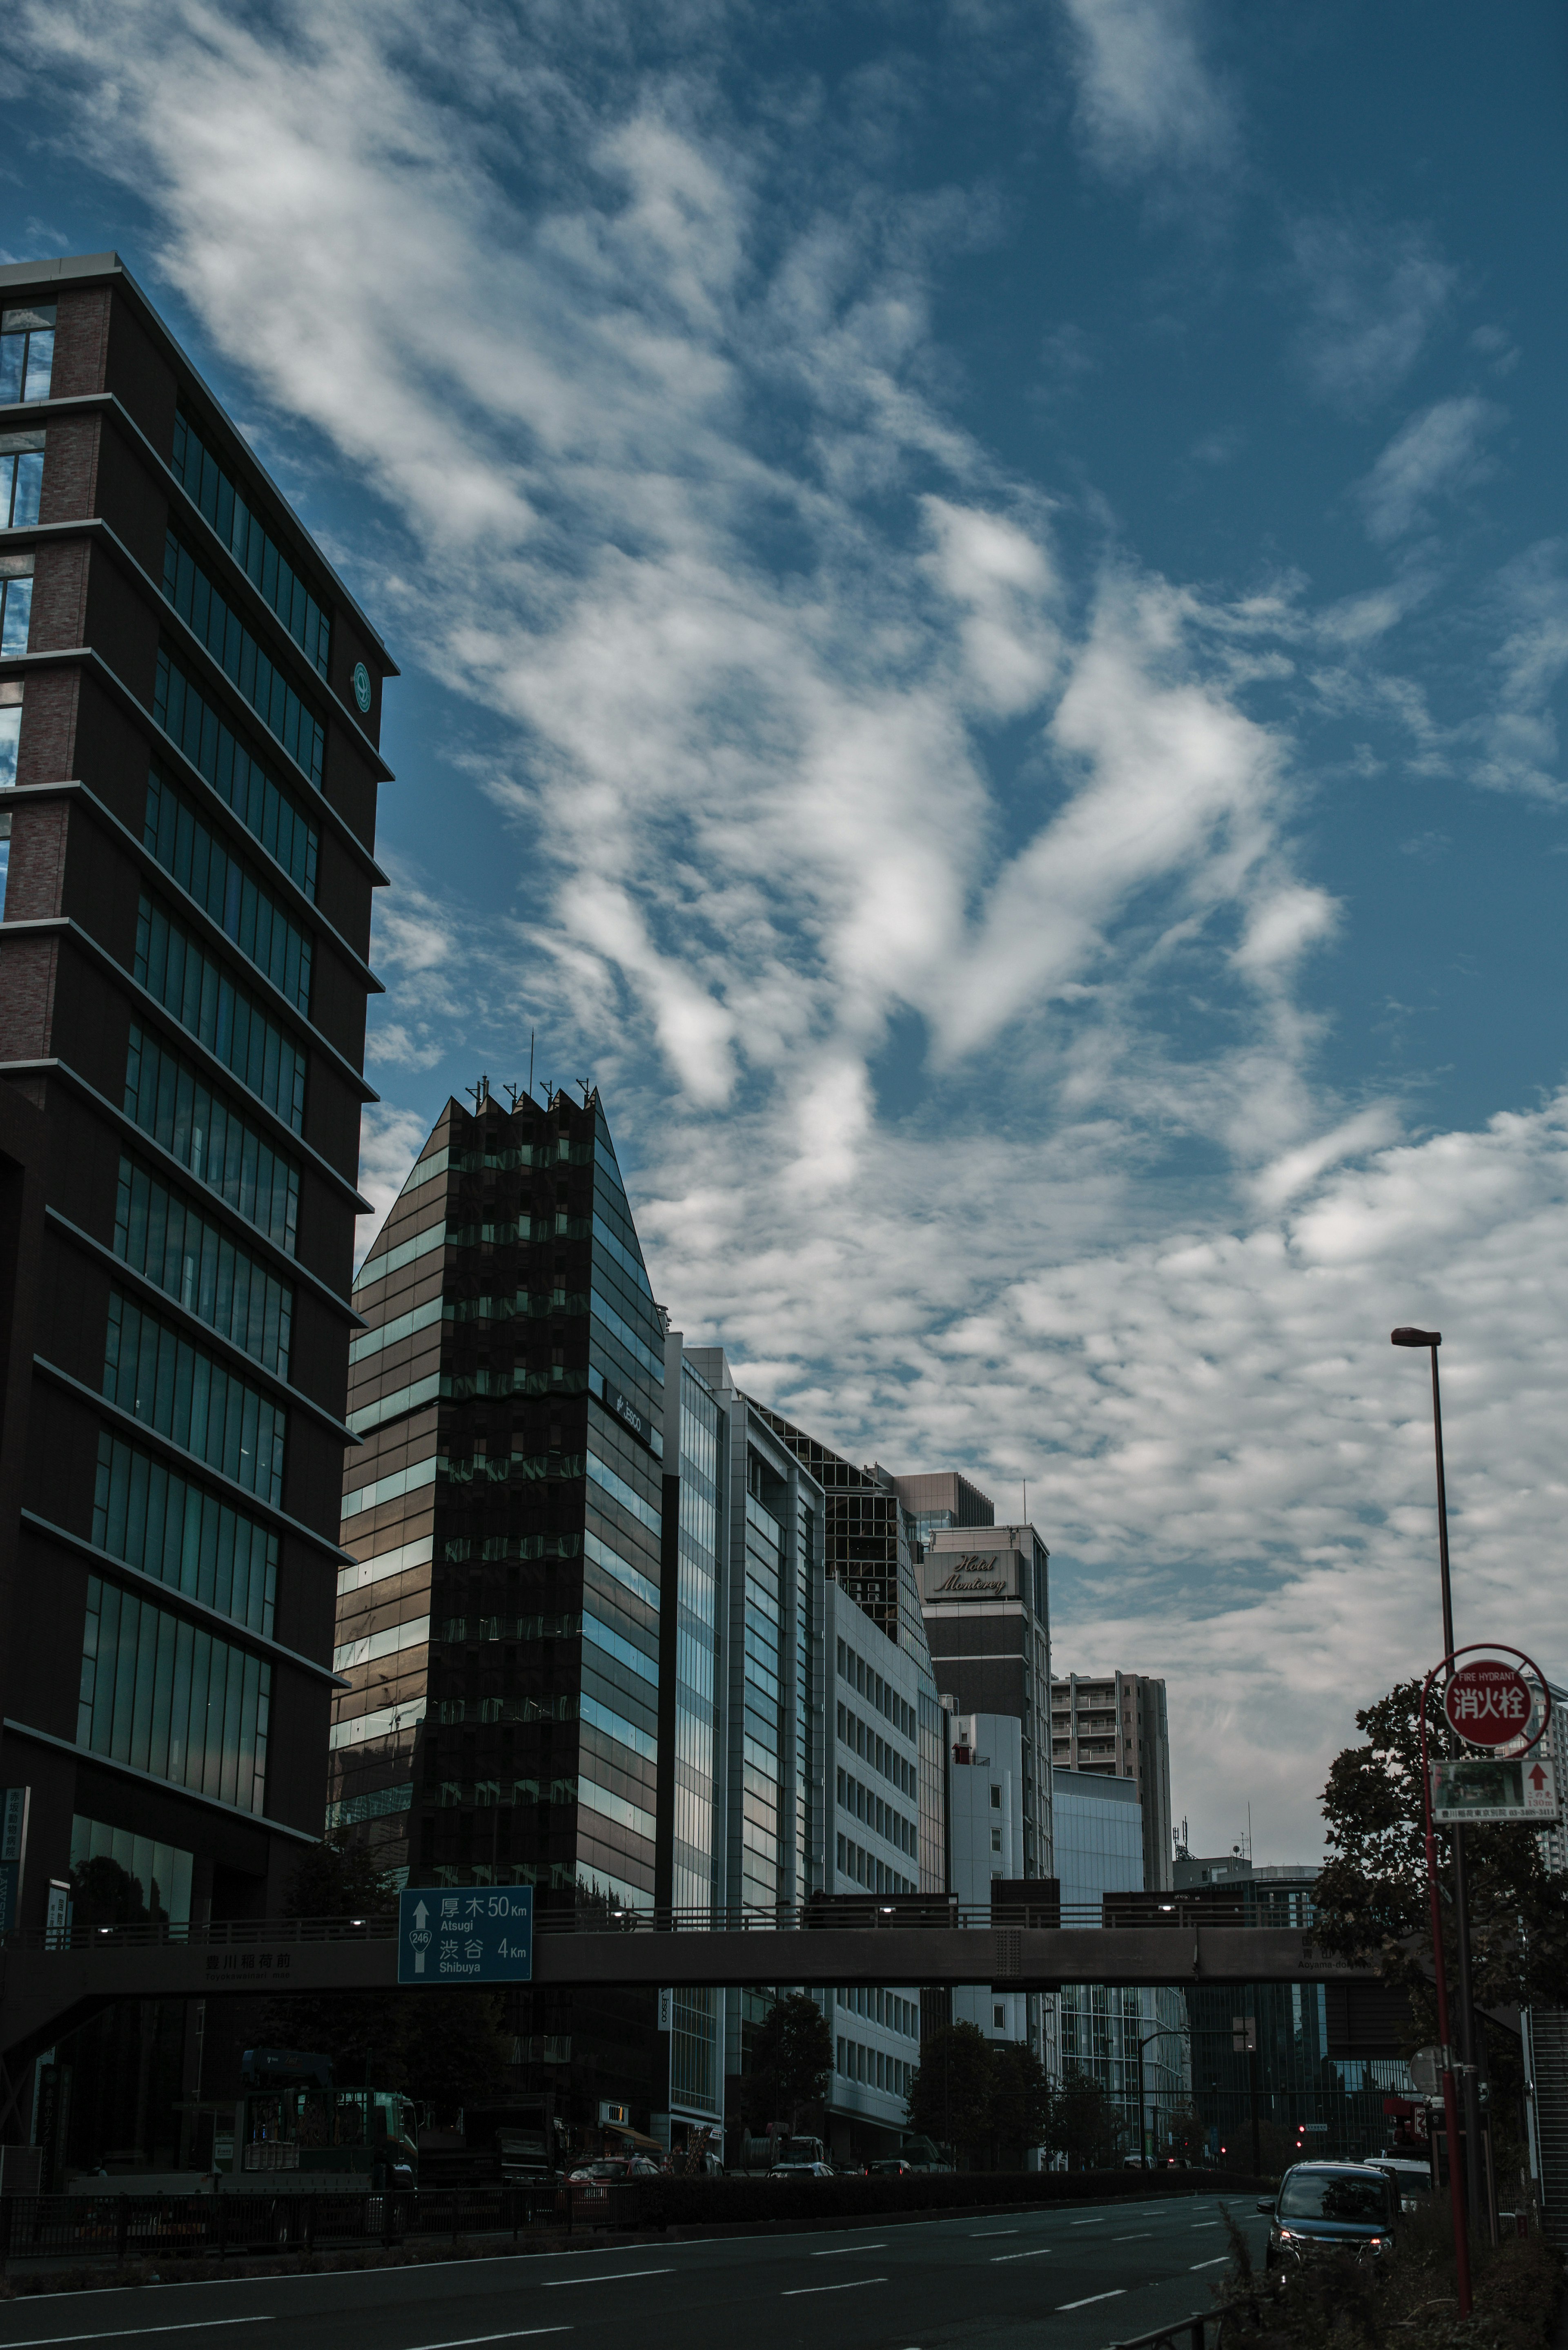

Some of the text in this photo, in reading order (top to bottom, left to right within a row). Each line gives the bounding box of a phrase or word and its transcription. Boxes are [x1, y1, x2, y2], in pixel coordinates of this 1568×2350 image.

[953, 1554, 997, 1572] Hotel
[933, 1573, 1005, 1595] Monterey
[1459, 1671, 1515, 1682] FIRE HYDRANT
[1453, 1686, 1525, 1720] 消火栓
[1527, 1790, 1553, 1799] この先
[1441, 1808, 1508, 1818] 豊川稲荷東京別院
[5, 1791, 20, 1857] 赤坂動物病院
[440, 1896, 527, 1917] 厚木 50 Km
[440, 1920, 473, 1933] Atsugi
[412, 1933, 428, 1943] 246
[439, 1938, 526, 1960] 渋谷 4 Km
[206, 1953, 291, 1970] 豊川稲荷前
[439, 1962, 481, 1974] Shibuya
[205, 1972, 267, 1982] Toyokawainari
